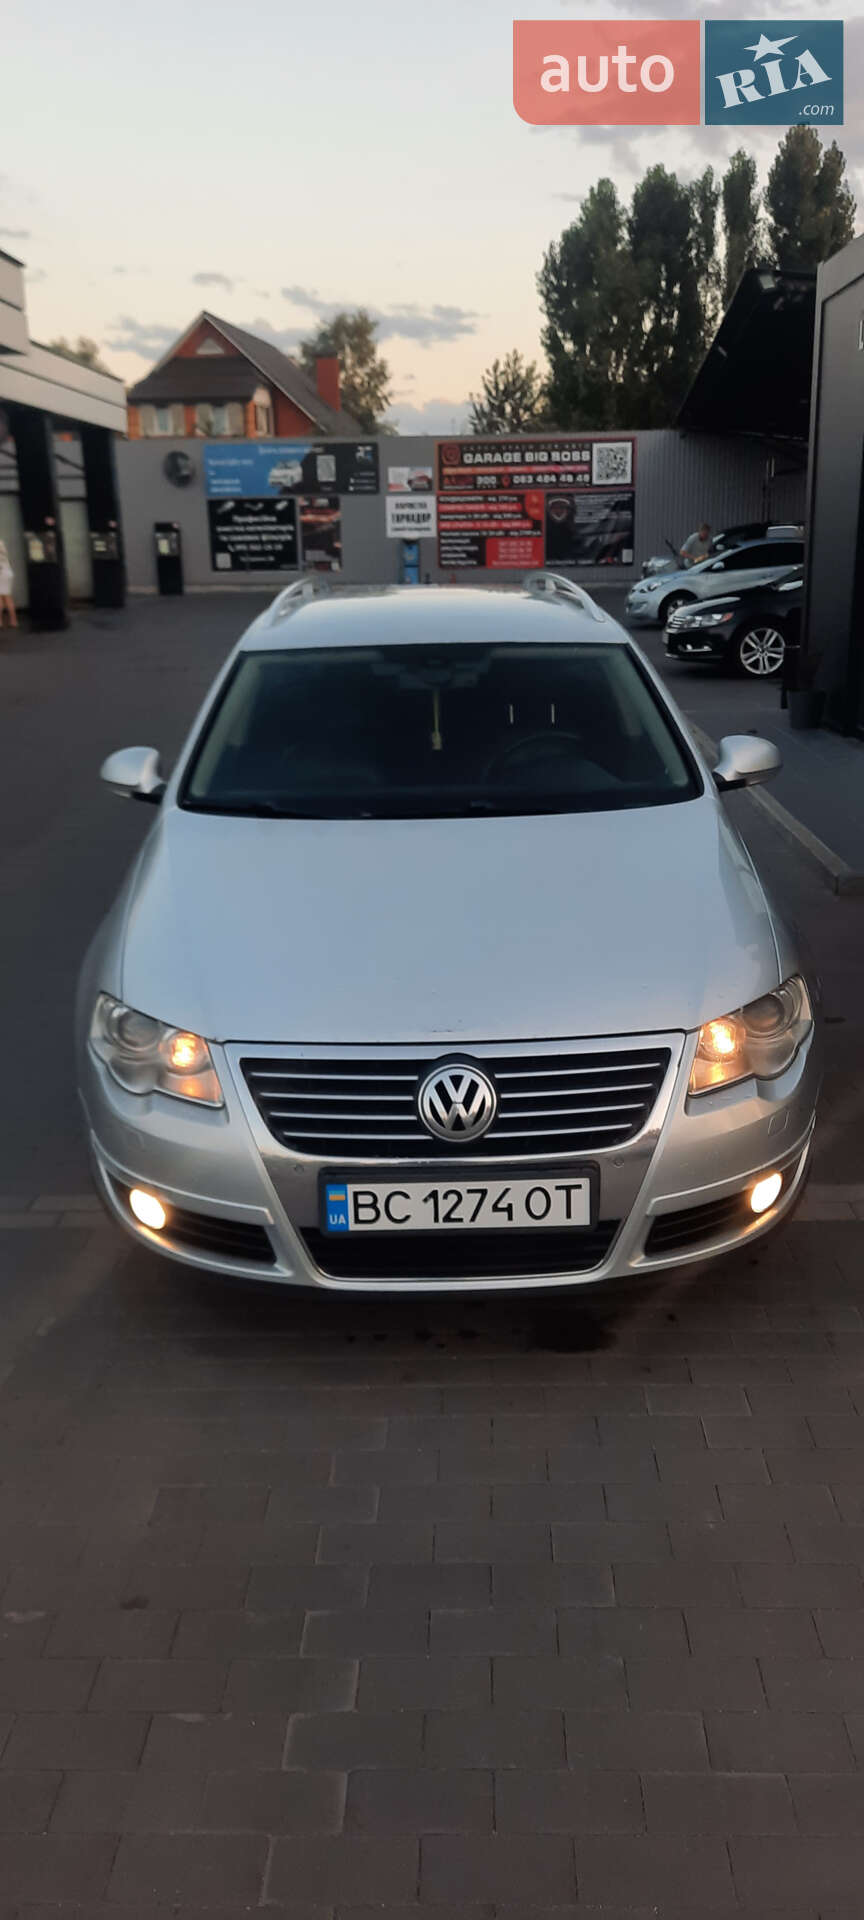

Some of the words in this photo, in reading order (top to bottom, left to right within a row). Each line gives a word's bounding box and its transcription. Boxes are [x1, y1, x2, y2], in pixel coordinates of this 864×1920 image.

[463, 452, 521, 464] GARAGE
[525, 451, 549, 462] BIG
[551, 450, 590, 462] BOSS
[352, 1190, 411, 1224] BC
[422, 1187, 513, 1223] 1274
[524, 1184, 582, 1220] OT
[329, 1215, 346, 1224] UA
